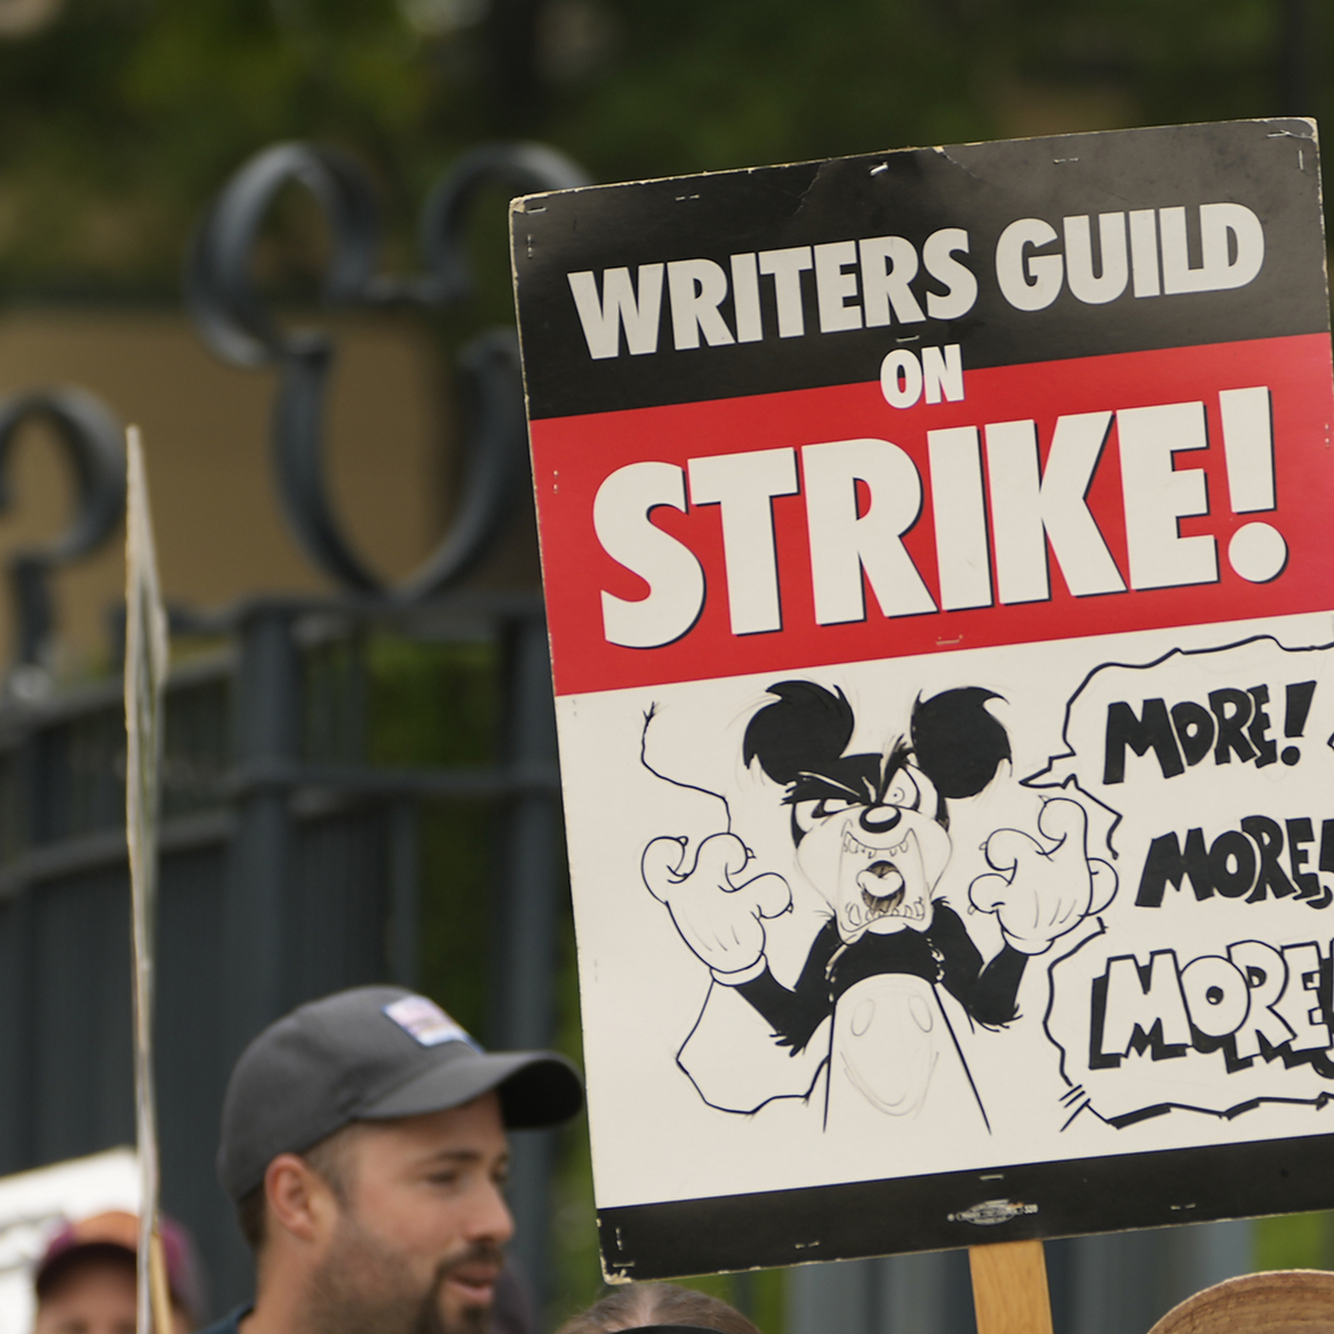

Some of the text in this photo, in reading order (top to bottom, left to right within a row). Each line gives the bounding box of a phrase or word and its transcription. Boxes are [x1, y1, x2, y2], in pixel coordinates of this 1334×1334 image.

[567, 201, 1266, 360] WRITERS GUILD
[880, 343, 965, 408] ON
[593, 385, 1288, 649] STRIKE!
[1104, 680, 1317, 786] MORE!
